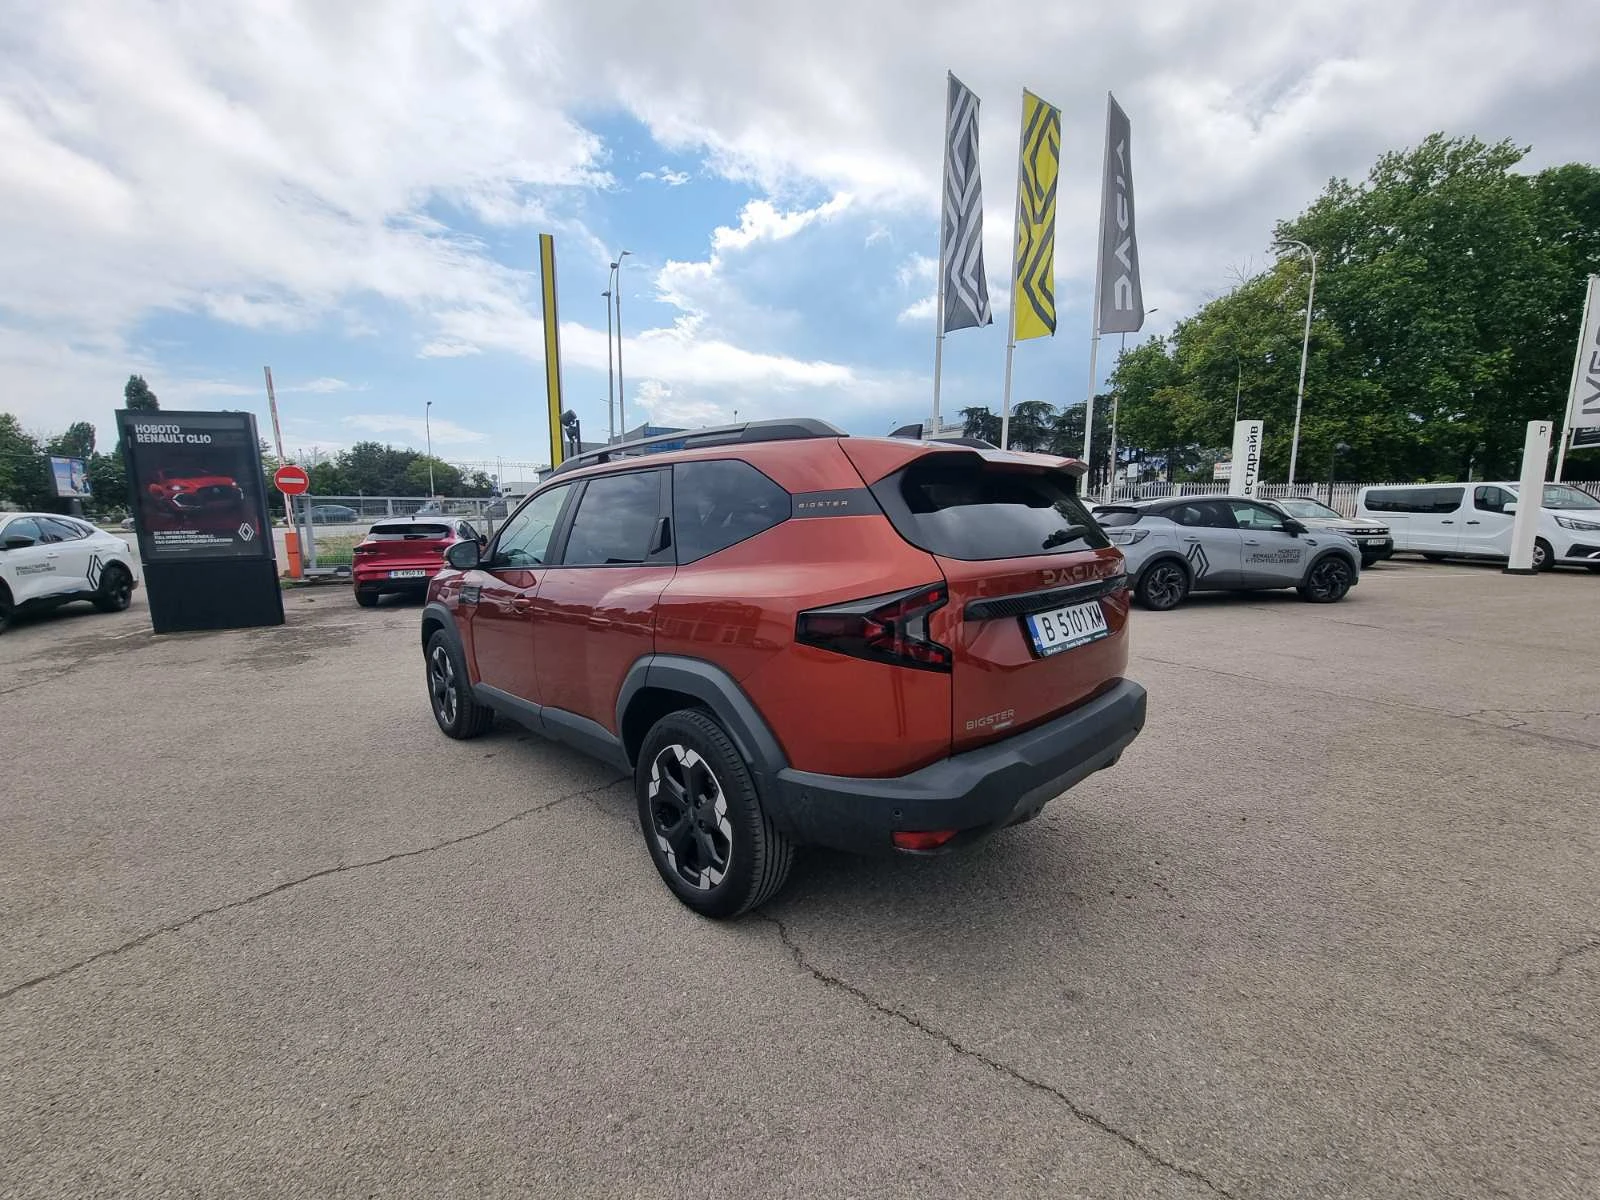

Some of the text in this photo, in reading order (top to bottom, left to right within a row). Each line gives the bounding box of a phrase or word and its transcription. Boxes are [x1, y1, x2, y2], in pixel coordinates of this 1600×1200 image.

[136, 434, 212, 444] RENAULT CLIO
[1243, 426, 1259, 496] естдрайв
[798, 500, 848, 509] BIGSTER
[1042, 564, 1104, 584] DACIA
[1042, 604, 1105, 641] B 5101 XM
[966, 709, 1015, 730] BIGSTER
